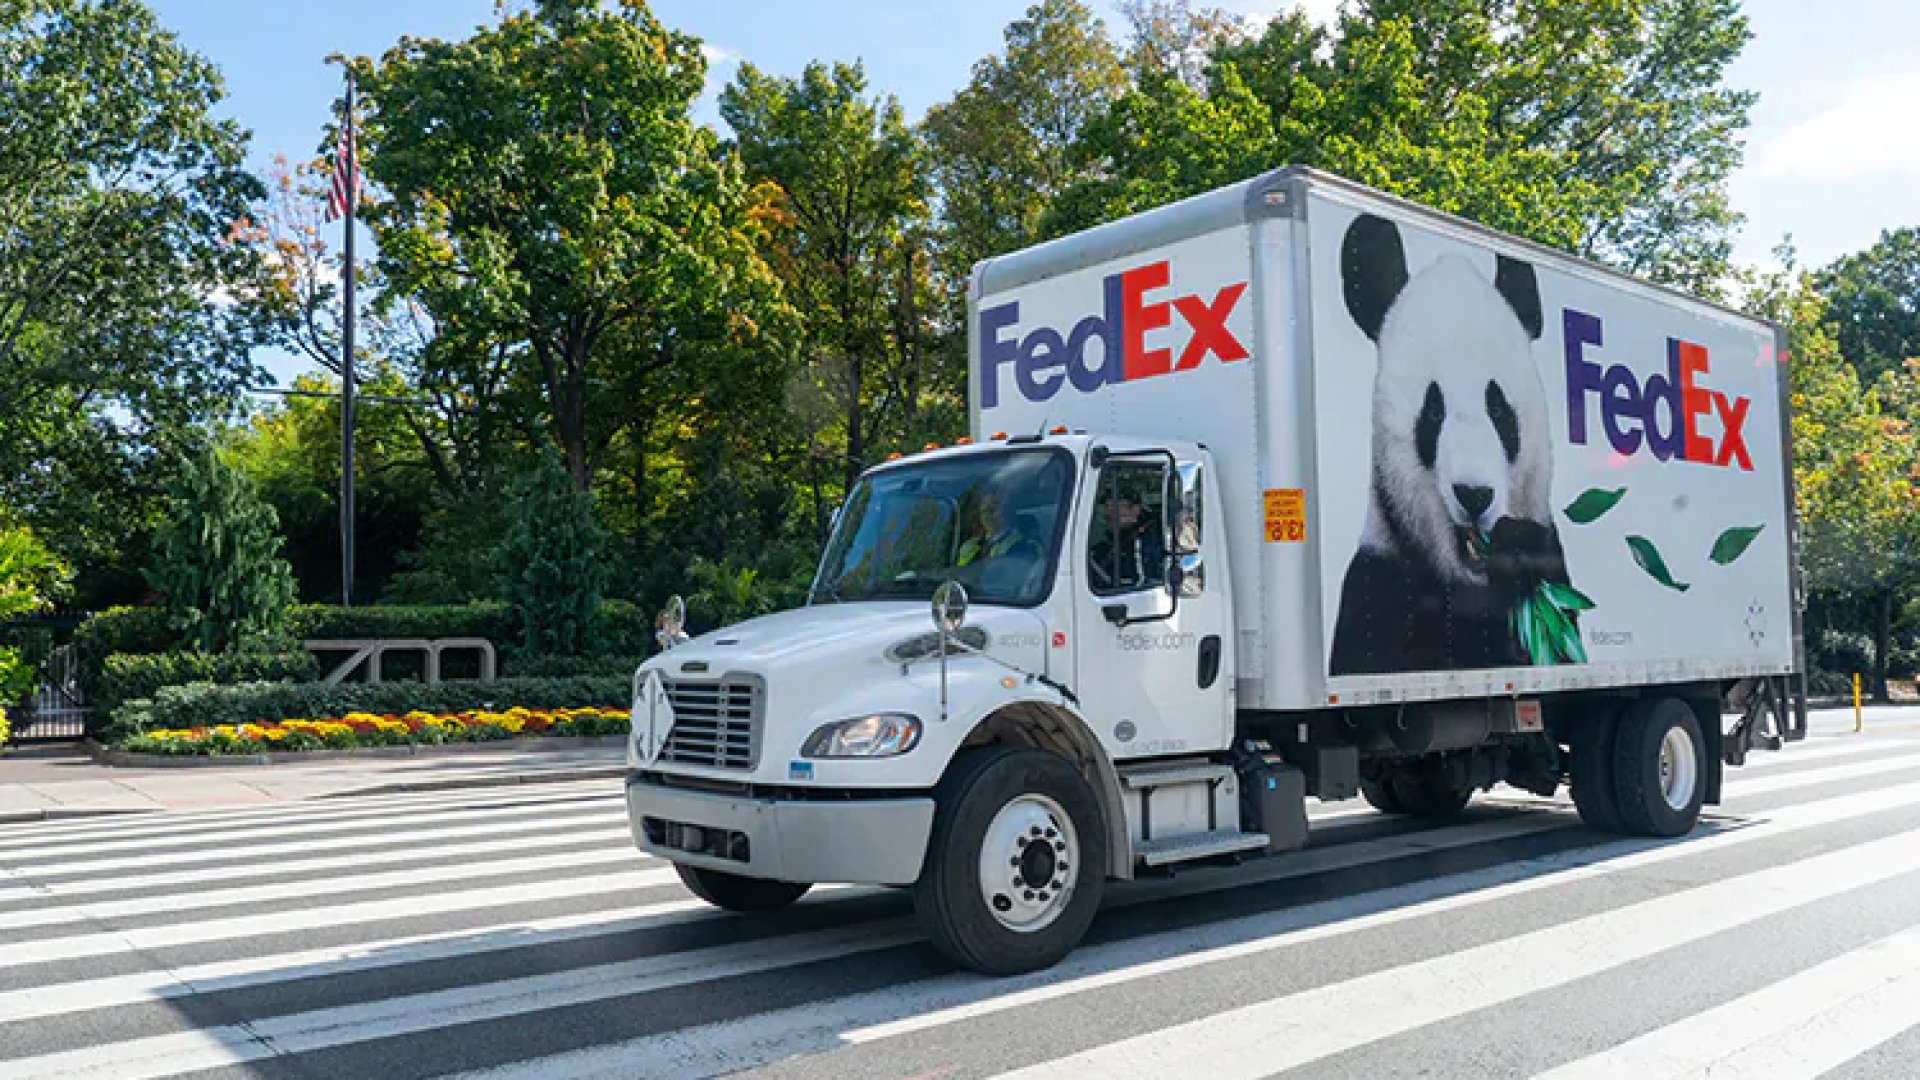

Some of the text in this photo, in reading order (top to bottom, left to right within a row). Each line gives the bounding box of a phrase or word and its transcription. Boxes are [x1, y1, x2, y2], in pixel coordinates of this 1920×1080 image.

[979, 260, 1249, 409] FedEx
[1563, 307, 1754, 471] FedEx
[304, 638, 494, 684] ZOO
